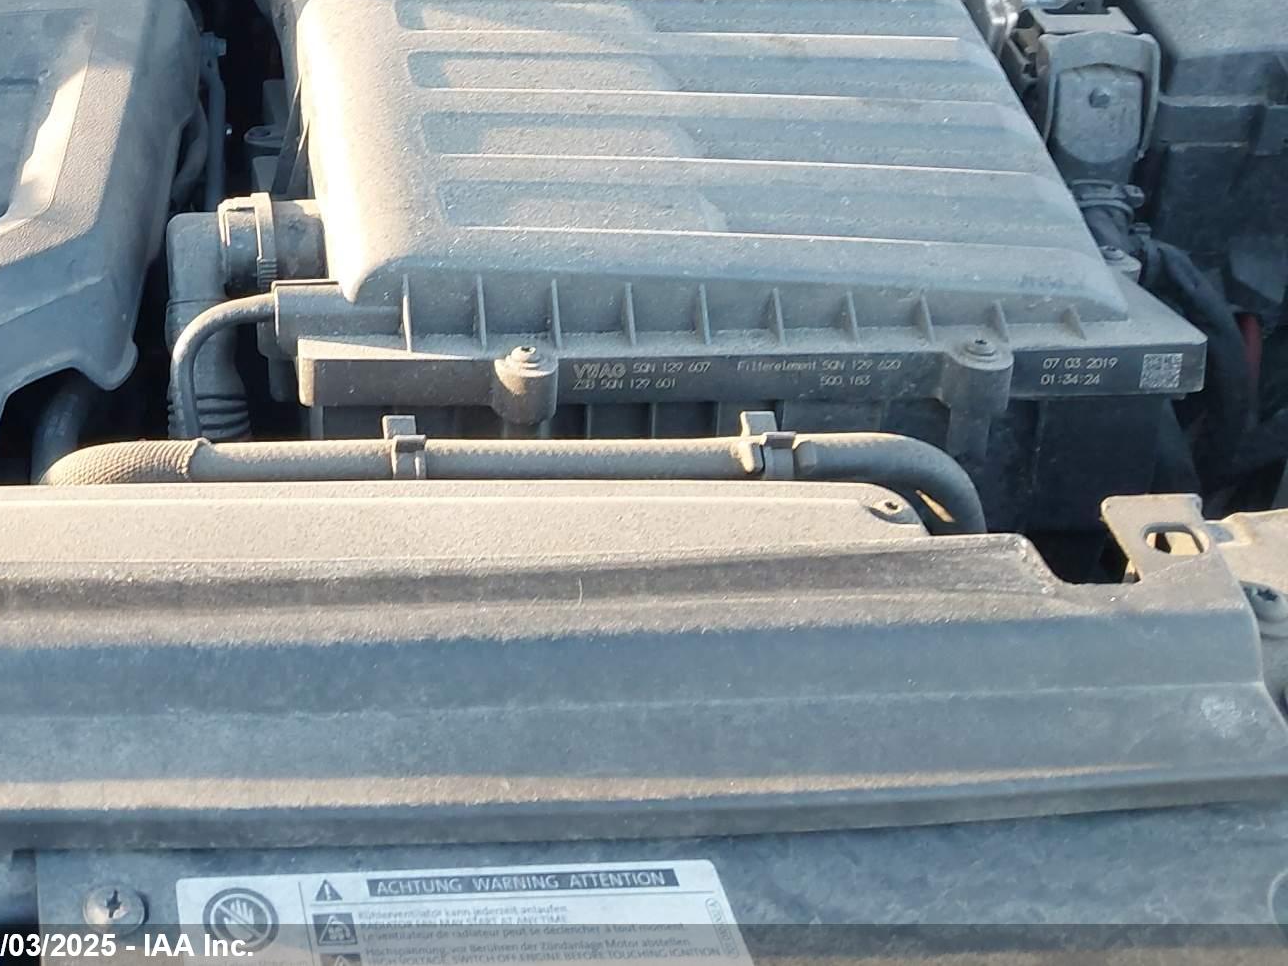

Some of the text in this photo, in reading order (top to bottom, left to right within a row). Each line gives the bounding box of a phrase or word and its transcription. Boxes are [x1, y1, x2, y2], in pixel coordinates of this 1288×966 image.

[736, 360, 816, 372] Filterelement
[852, 359, 873, 370] 129
[877, 358, 902, 370] 620
[1086, 357, 1119, 369] 2019
[573, 362, 626, 379] VWAG
[662, 361, 684, 373] 129
[687, 361, 711, 373] 607
[630, 377, 651, 389] 129
[655, 377, 676, 389] 601
[1040, 373, 1101, 385] 01:34:24
[376, 871, 666, 896] ACHTUNG WARNING ATTENTION
[604, 938, 639, 948] Motor
[606, 949, 667, 959] TOUCHING
[669, 946, 721, 957] IGNITION
